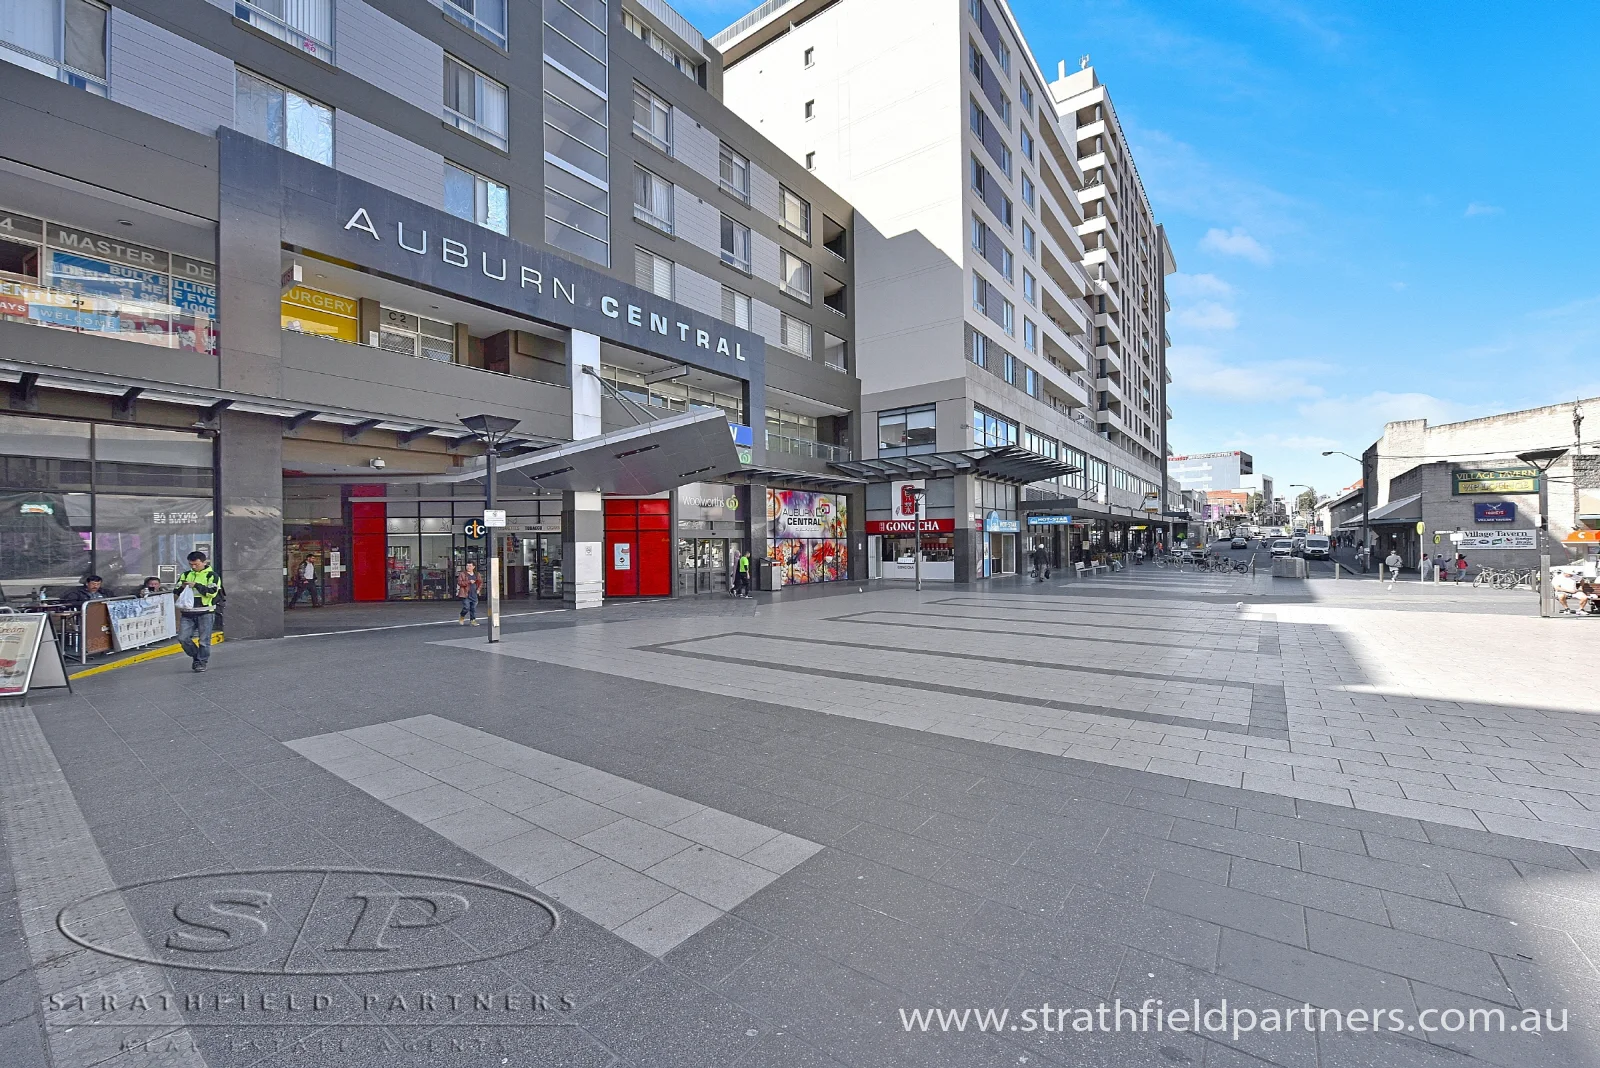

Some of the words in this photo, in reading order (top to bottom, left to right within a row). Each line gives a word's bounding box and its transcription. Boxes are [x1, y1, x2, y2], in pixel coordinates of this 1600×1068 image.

[59, 231, 155, 265] MASTER
[185, 262, 216, 281] DE
[109, 266, 154, 284] BULK
[343, 207, 576, 304] AUBURN
[600, 295, 747, 361] CENTRAL
[40, 309, 116, 329] WELCOME
[1456, 472, 1495, 480] VILLAGE
[1499, 469, 1537, 477] TAVERN
[682, 495, 725, 508] Woolworths
[783, 508, 815, 517] AUBURN
[787, 517, 821, 526] CENTRAL
[885, 521, 915, 532] GONG
[918, 520, 940, 531] CHA
[464, 519, 486, 539] ctc
[1464, 530, 1494, 538] Village
